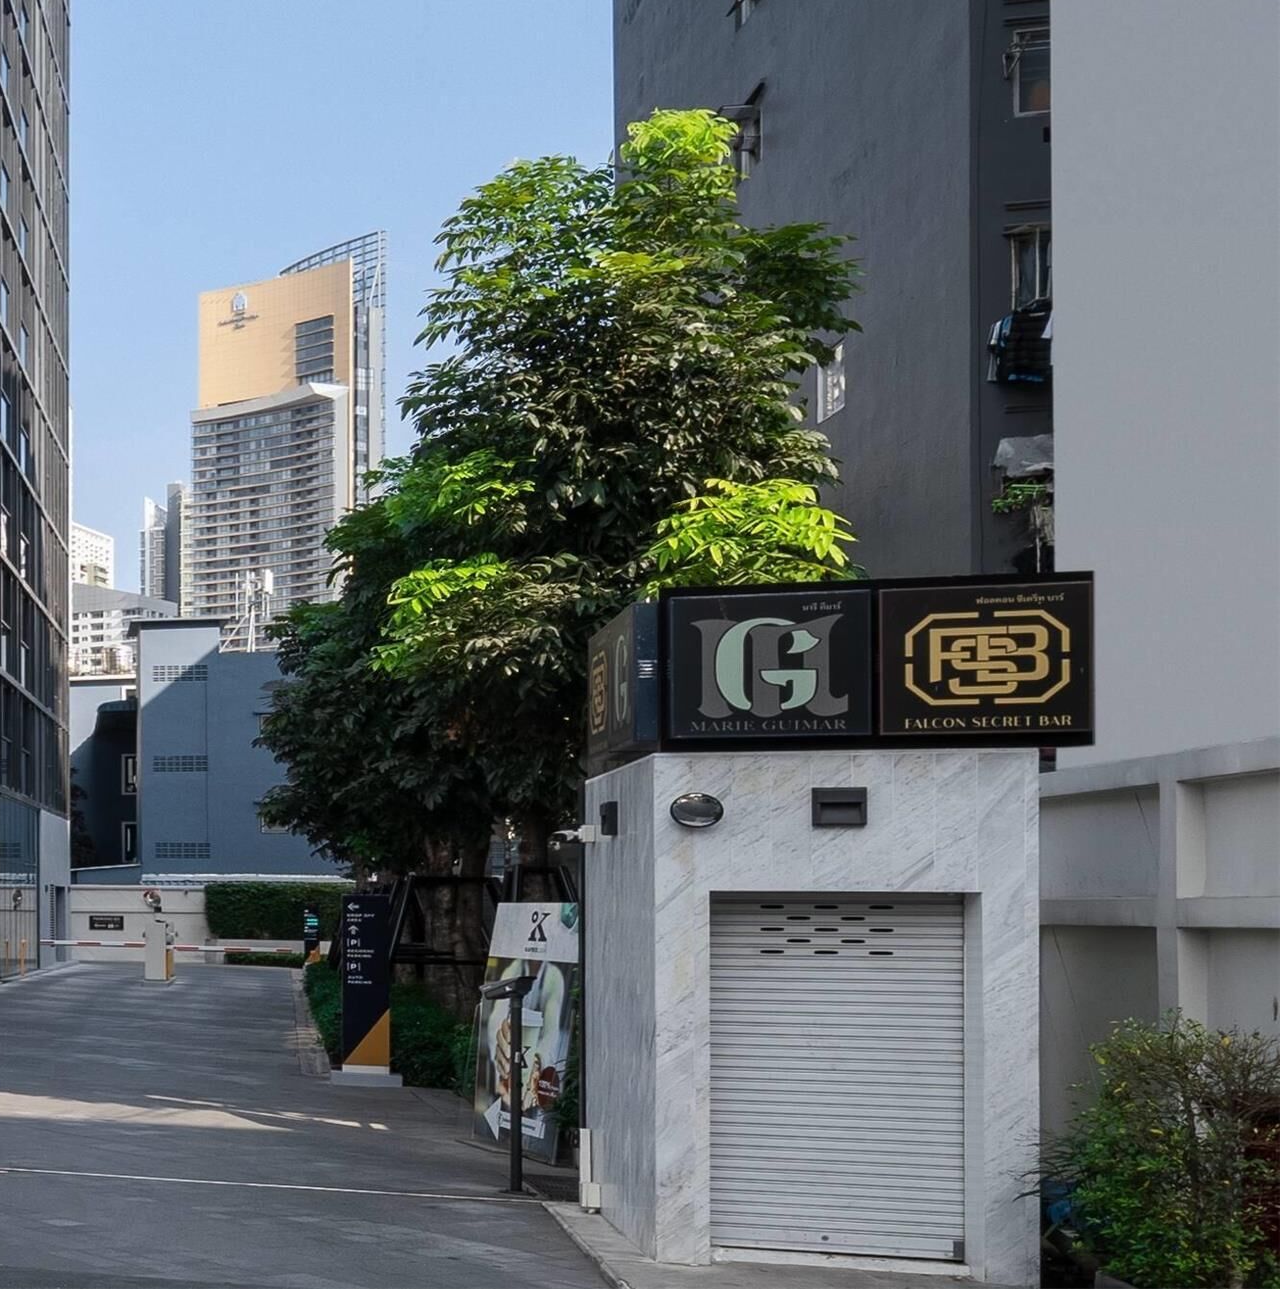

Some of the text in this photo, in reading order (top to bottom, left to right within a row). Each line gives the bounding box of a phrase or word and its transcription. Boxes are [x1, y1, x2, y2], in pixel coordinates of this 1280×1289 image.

[691, 719, 846, 731] MARIE GUIMAR
[904, 715, 1072, 729] FALCON SECRET BAR
